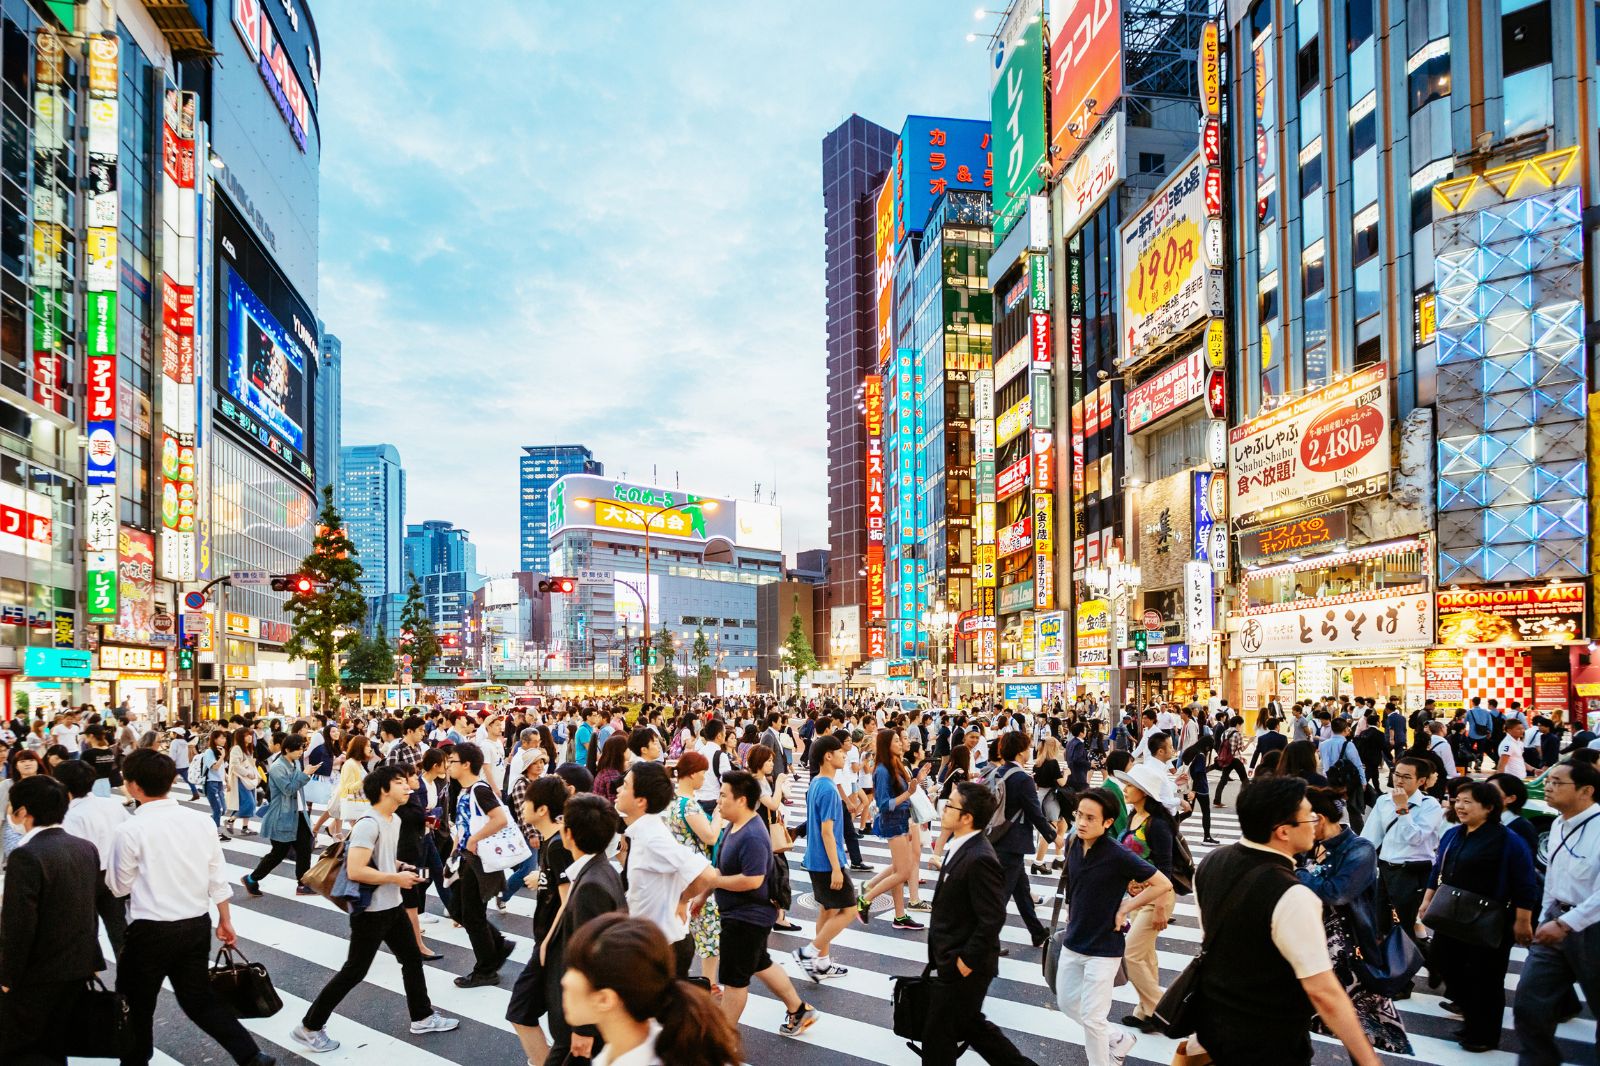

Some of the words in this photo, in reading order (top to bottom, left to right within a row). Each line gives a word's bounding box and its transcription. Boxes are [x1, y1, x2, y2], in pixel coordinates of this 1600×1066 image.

[1006, 67, 1024, 189] レイク
[929, 128, 947, 194] カラオ
[1077, 162, 1115, 214] アイフル
[1138, 236, 1193, 300] 190円
[1036, 326, 1048, 361] アイフル
[92, 359, 113, 417] アイフル
[1191, 380, 1202, 395] 1F
[1341, 381, 1350, 393] 2
[869, 382, 881, 436] パチンコ
[92, 440, 112, 456] 薬
[1234, 421, 1299, 463] しゃぶしゃぶ
[1308, 424, 1362, 467] 2,480
[1361, 437, 1376, 450] yen
[1237, 458, 1297, 497] 食べ放題!
[1366, 475, 1388, 495] 5F
[613, 484, 675, 509] たのめーる
[91, 489, 114, 547] 大勝軒
[604, 506, 686, 531] 大塚商会
[1036, 511, 1048, 540] 金の蔵
[1261, 528, 1331, 554] キャンパスコース
[95, 573, 110, 608] レイク
[871, 563, 882, 606] パチンコ
[1438, 590, 1529, 606] OKONOMI
[1534, 587, 1583, 601] YAKI
[1299, 601, 1406, 644] とらそば
[1517, 602, 1533, 610] with
[56, 616, 74, 643] 薬
